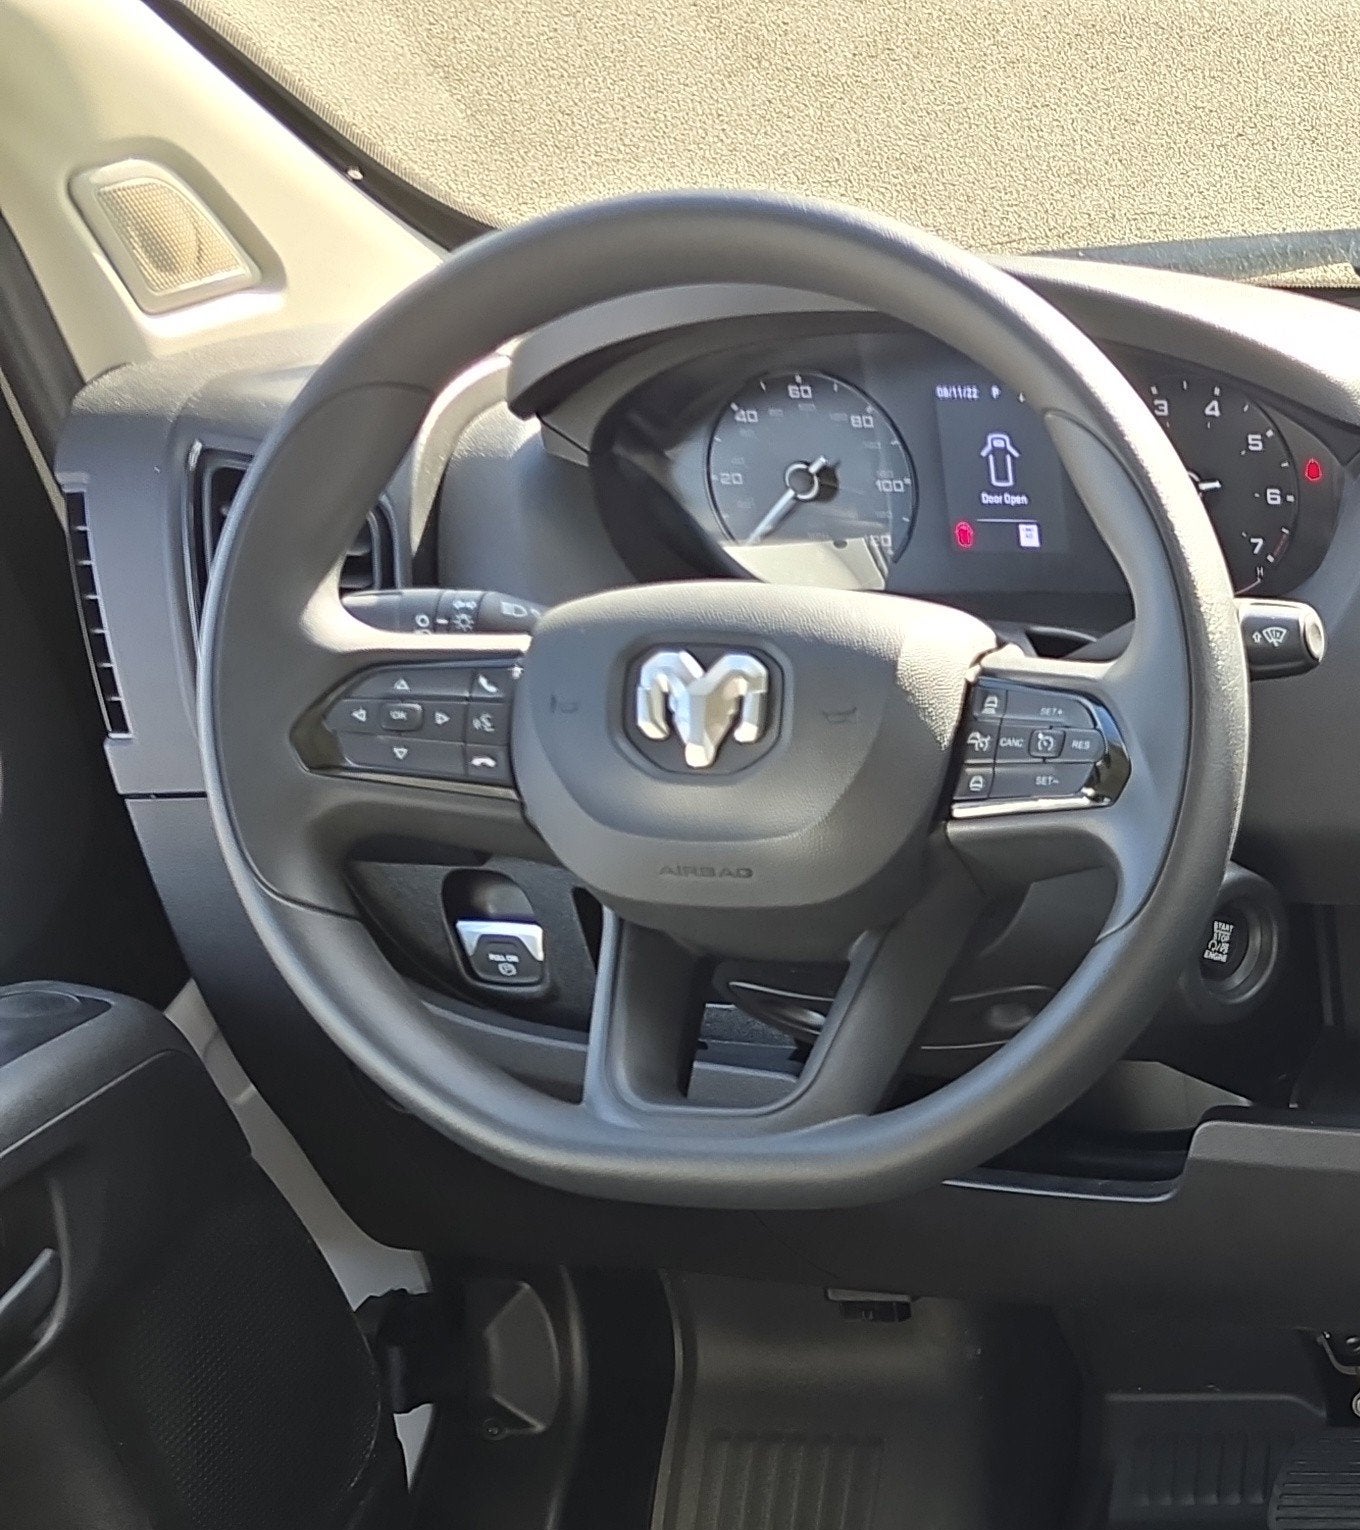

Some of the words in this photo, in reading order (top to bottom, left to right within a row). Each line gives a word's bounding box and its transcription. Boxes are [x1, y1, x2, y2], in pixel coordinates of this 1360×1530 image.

[787, 385, 812, 399] 60
[1154, 399, 1169, 416] 3
[1204, 400, 1220, 417] 4
[734, 409, 759, 424] 40
[850, 415, 875, 429] 80
[1247, 434, 1263, 451] 5
[720, 473, 743, 485] 20
[876, 479, 904, 492] 100
[981, 492, 1002, 504] Door
[1004, 492, 1029, 506] Open
[1266, 488, 1281, 505] 6
[1250, 538, 1264, 554] 7
[1000, 738, 1024, 748] CANC
[659, 864, 754, 879] AIRBAG
